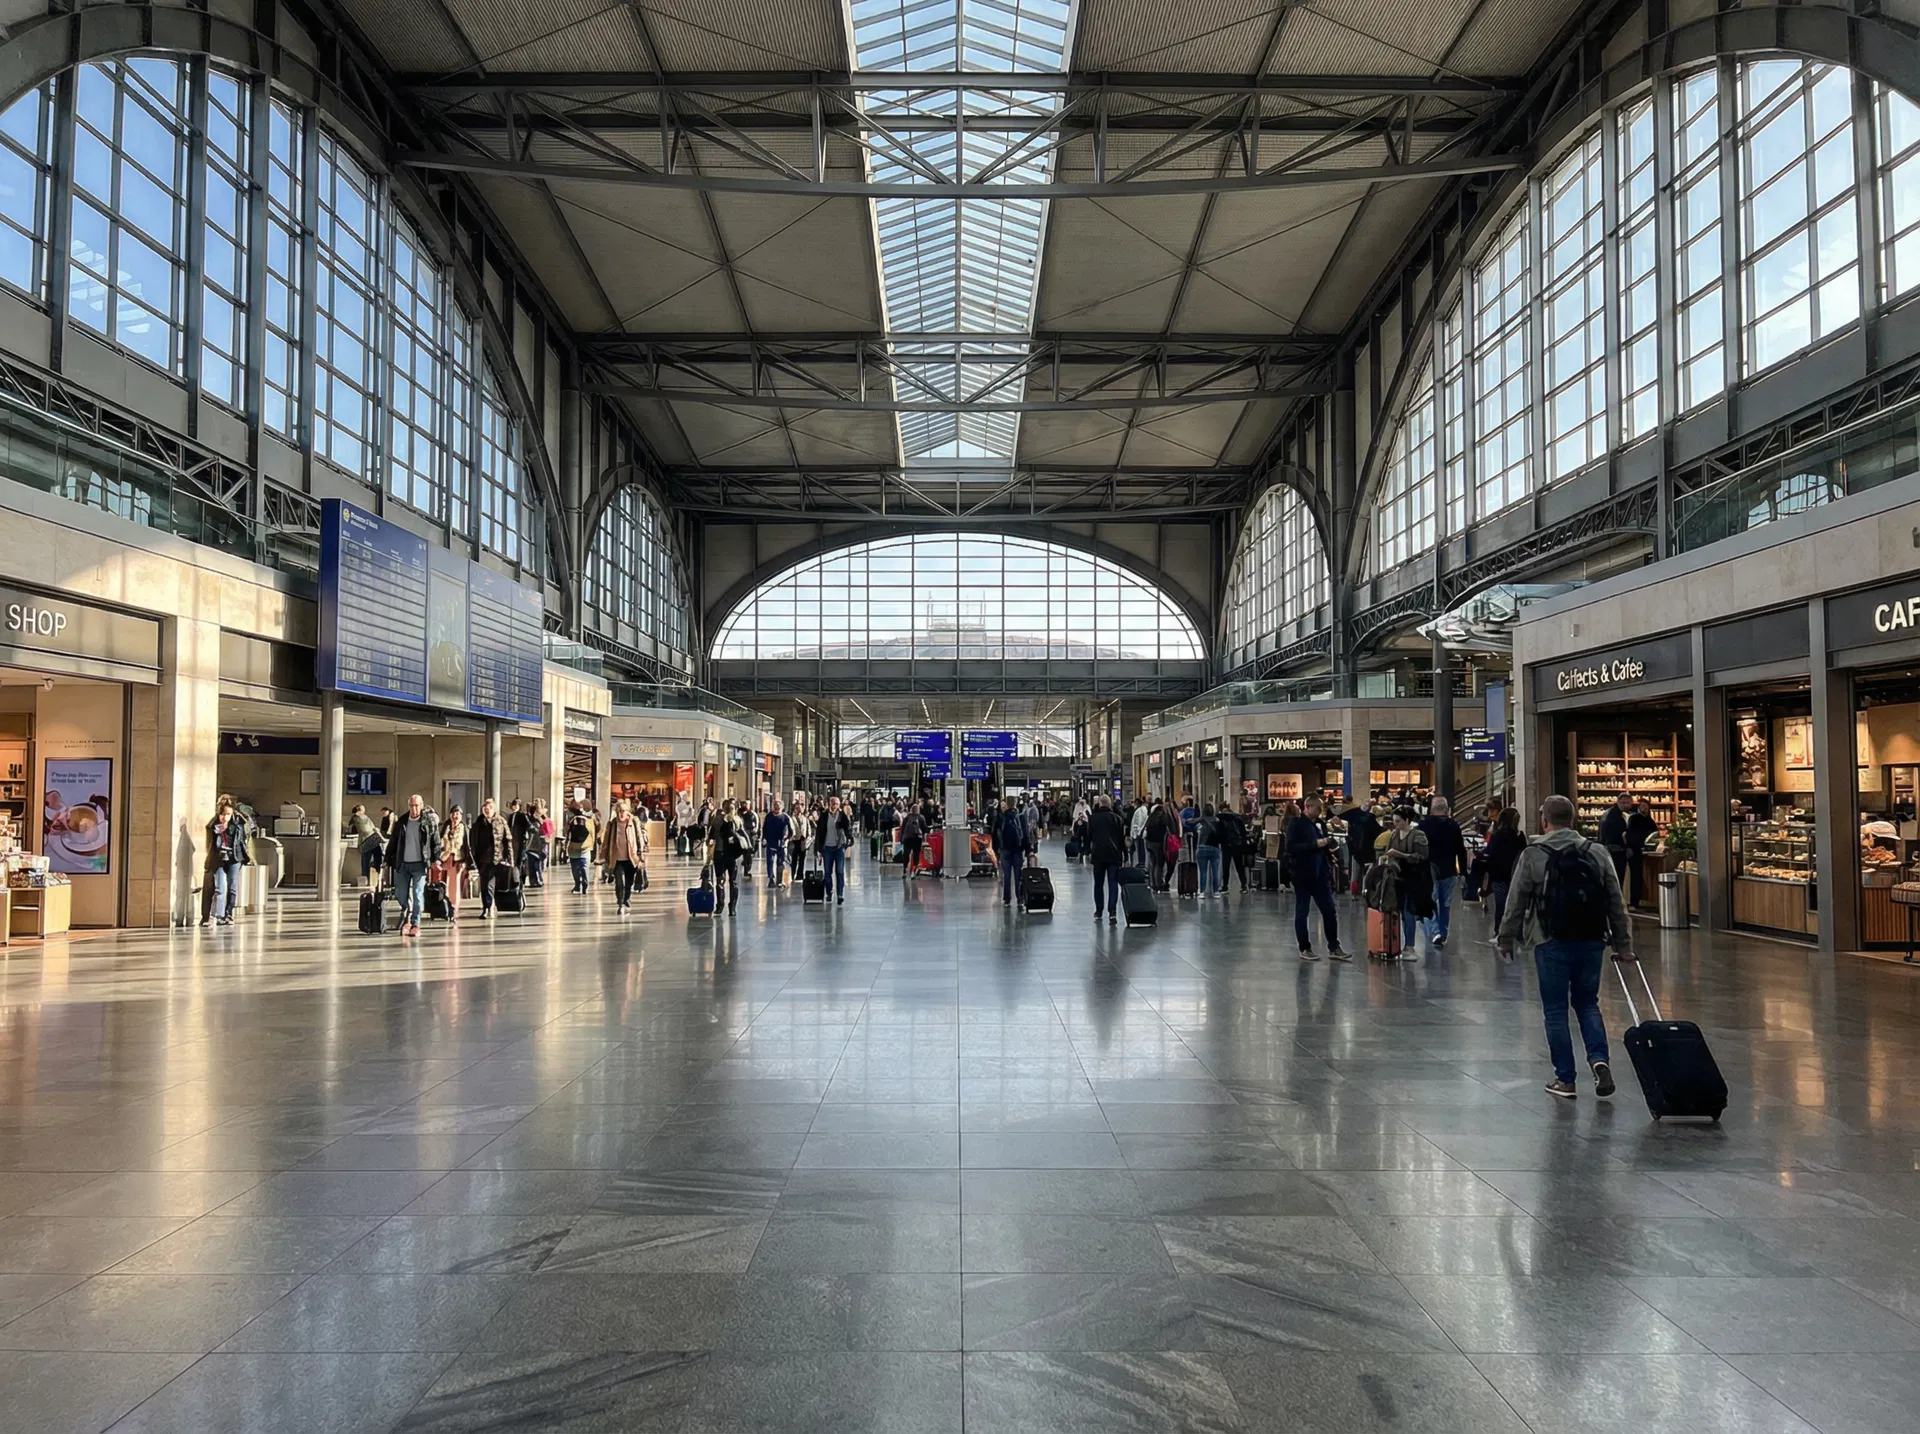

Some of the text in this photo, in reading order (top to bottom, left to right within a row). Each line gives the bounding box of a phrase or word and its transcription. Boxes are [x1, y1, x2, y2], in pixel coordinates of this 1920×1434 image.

[8, 603, 68, 637] SHOP
[1874, 596, 1920, 632] CAF
[1600, 663, 1610, 683] &
